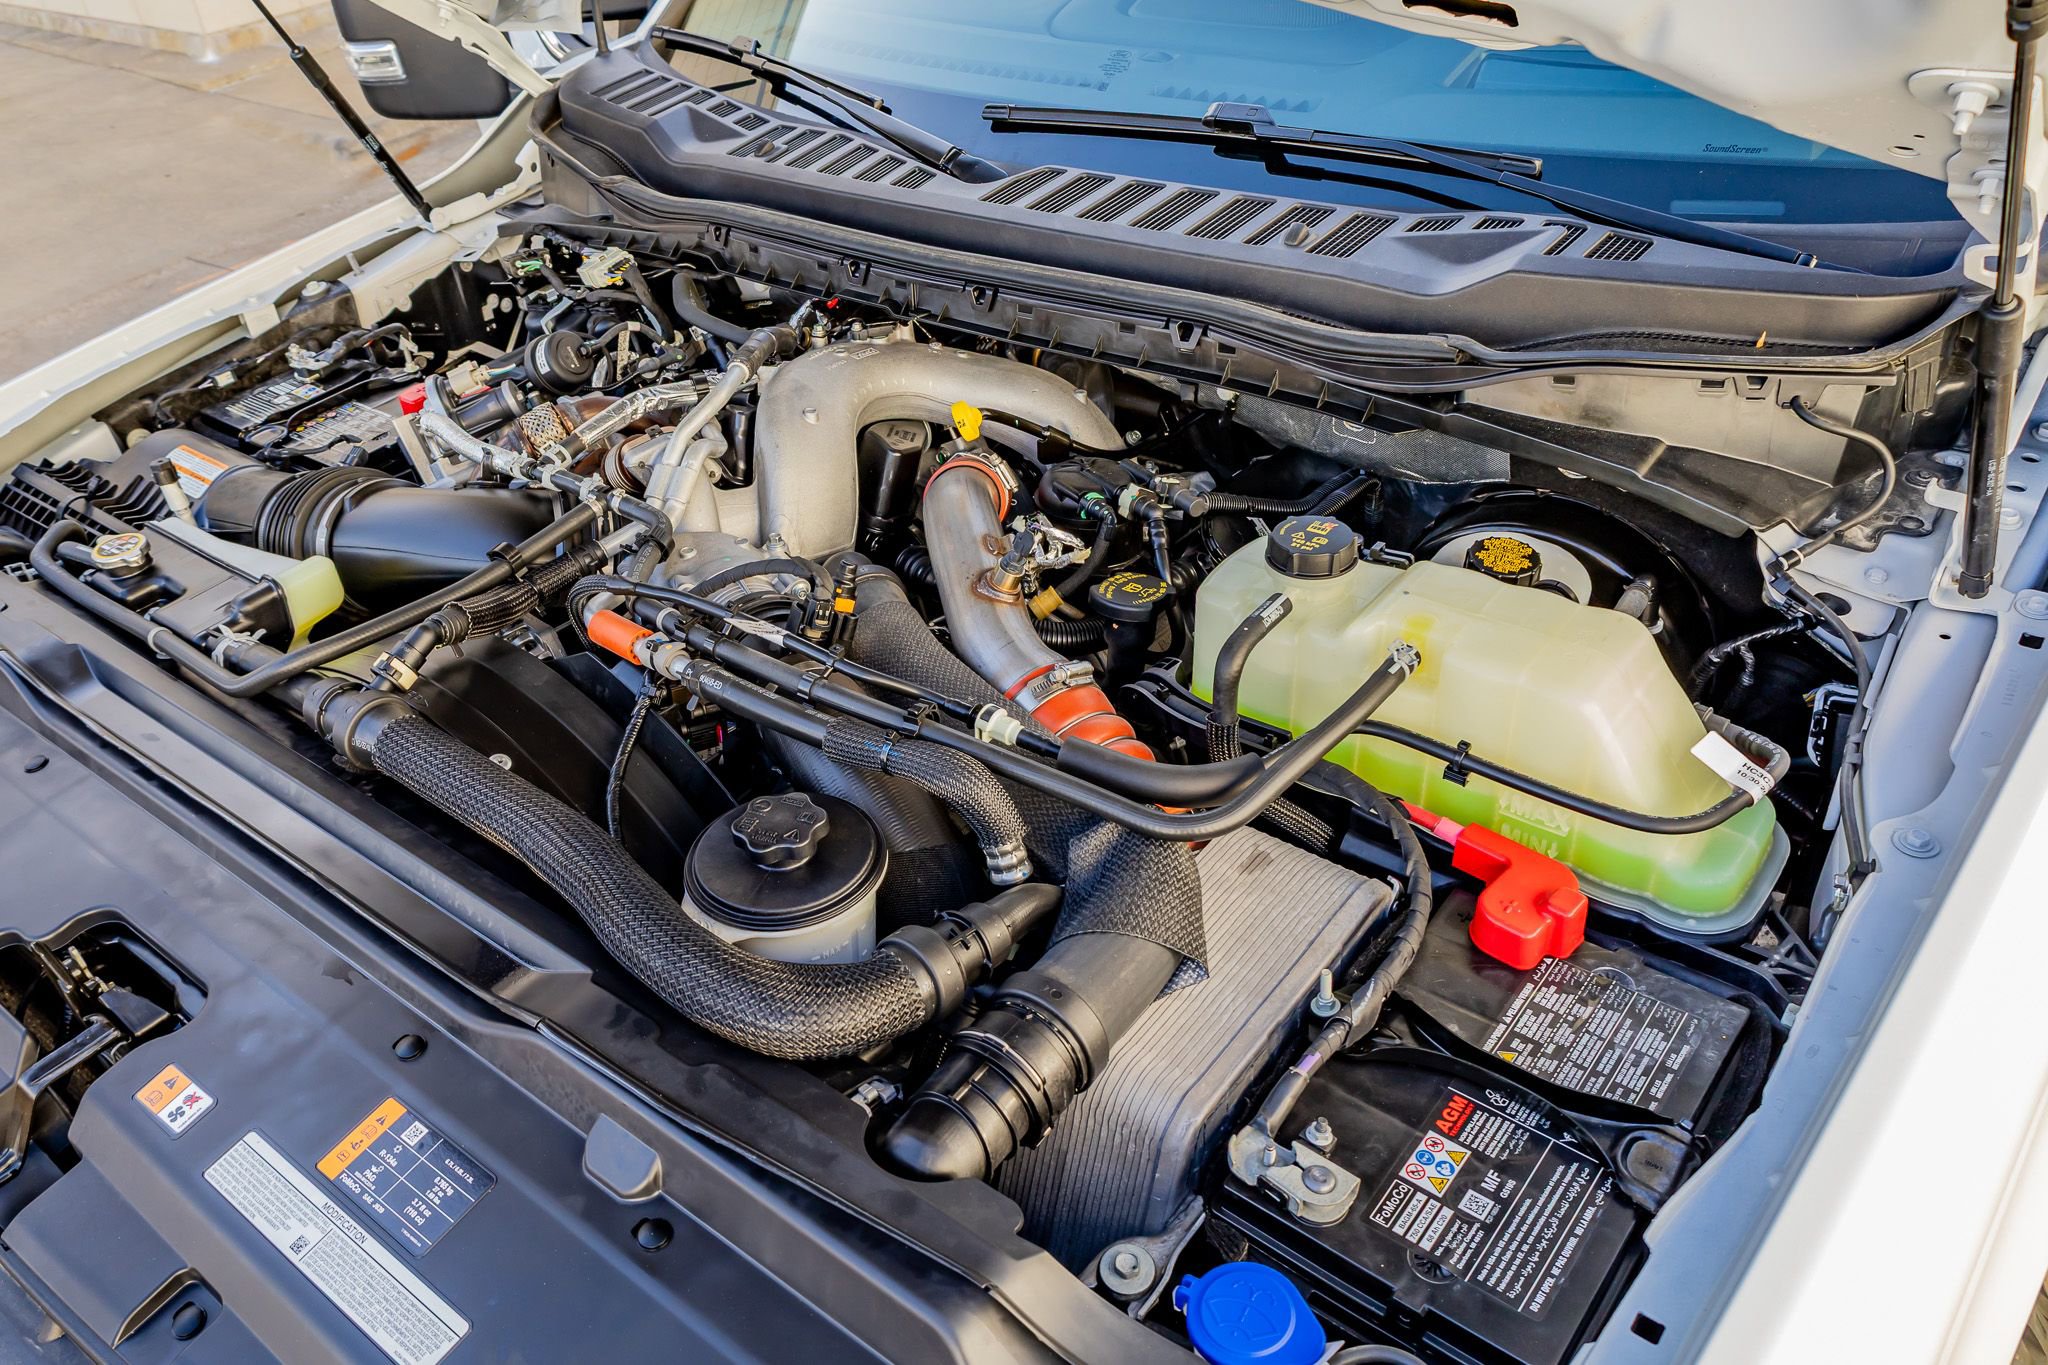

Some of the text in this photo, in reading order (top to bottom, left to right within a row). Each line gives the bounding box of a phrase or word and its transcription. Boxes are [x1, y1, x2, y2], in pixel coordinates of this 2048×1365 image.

[1434, 1092, 1468, 1134] AGM
[1449, 1102, 1475, 1137] TECHNOLOGY
[378, 1150, 398, 1167] R-134a
[338, 1172, 362, 1194] FoMoCo
[362, 1169, 377, 1182] PAG
[1481, 1168, 1503, 1193] MF
[1375, 1181, 1408, 1224] FoMoCo
[1398, 1196, 1422, 1230] BAGM-65-A
[320, 1200, 368, 1245] MODIFICATION
[1415, 1201, 1437, 1229] CCA/SAE
[1430, 1224, 1440, 1235] Ah
[1435, 1212, 1447, 1226] C20
[1550, 1265, 1561, 1276] NE
[1554, 1254, 1567, 1269] PAS
[1539, 1273, 1556, 1293] OPEN.
[1528, 1300, 1540, 1312] DO
[1533, 1289, 1547, 1304] NOT
